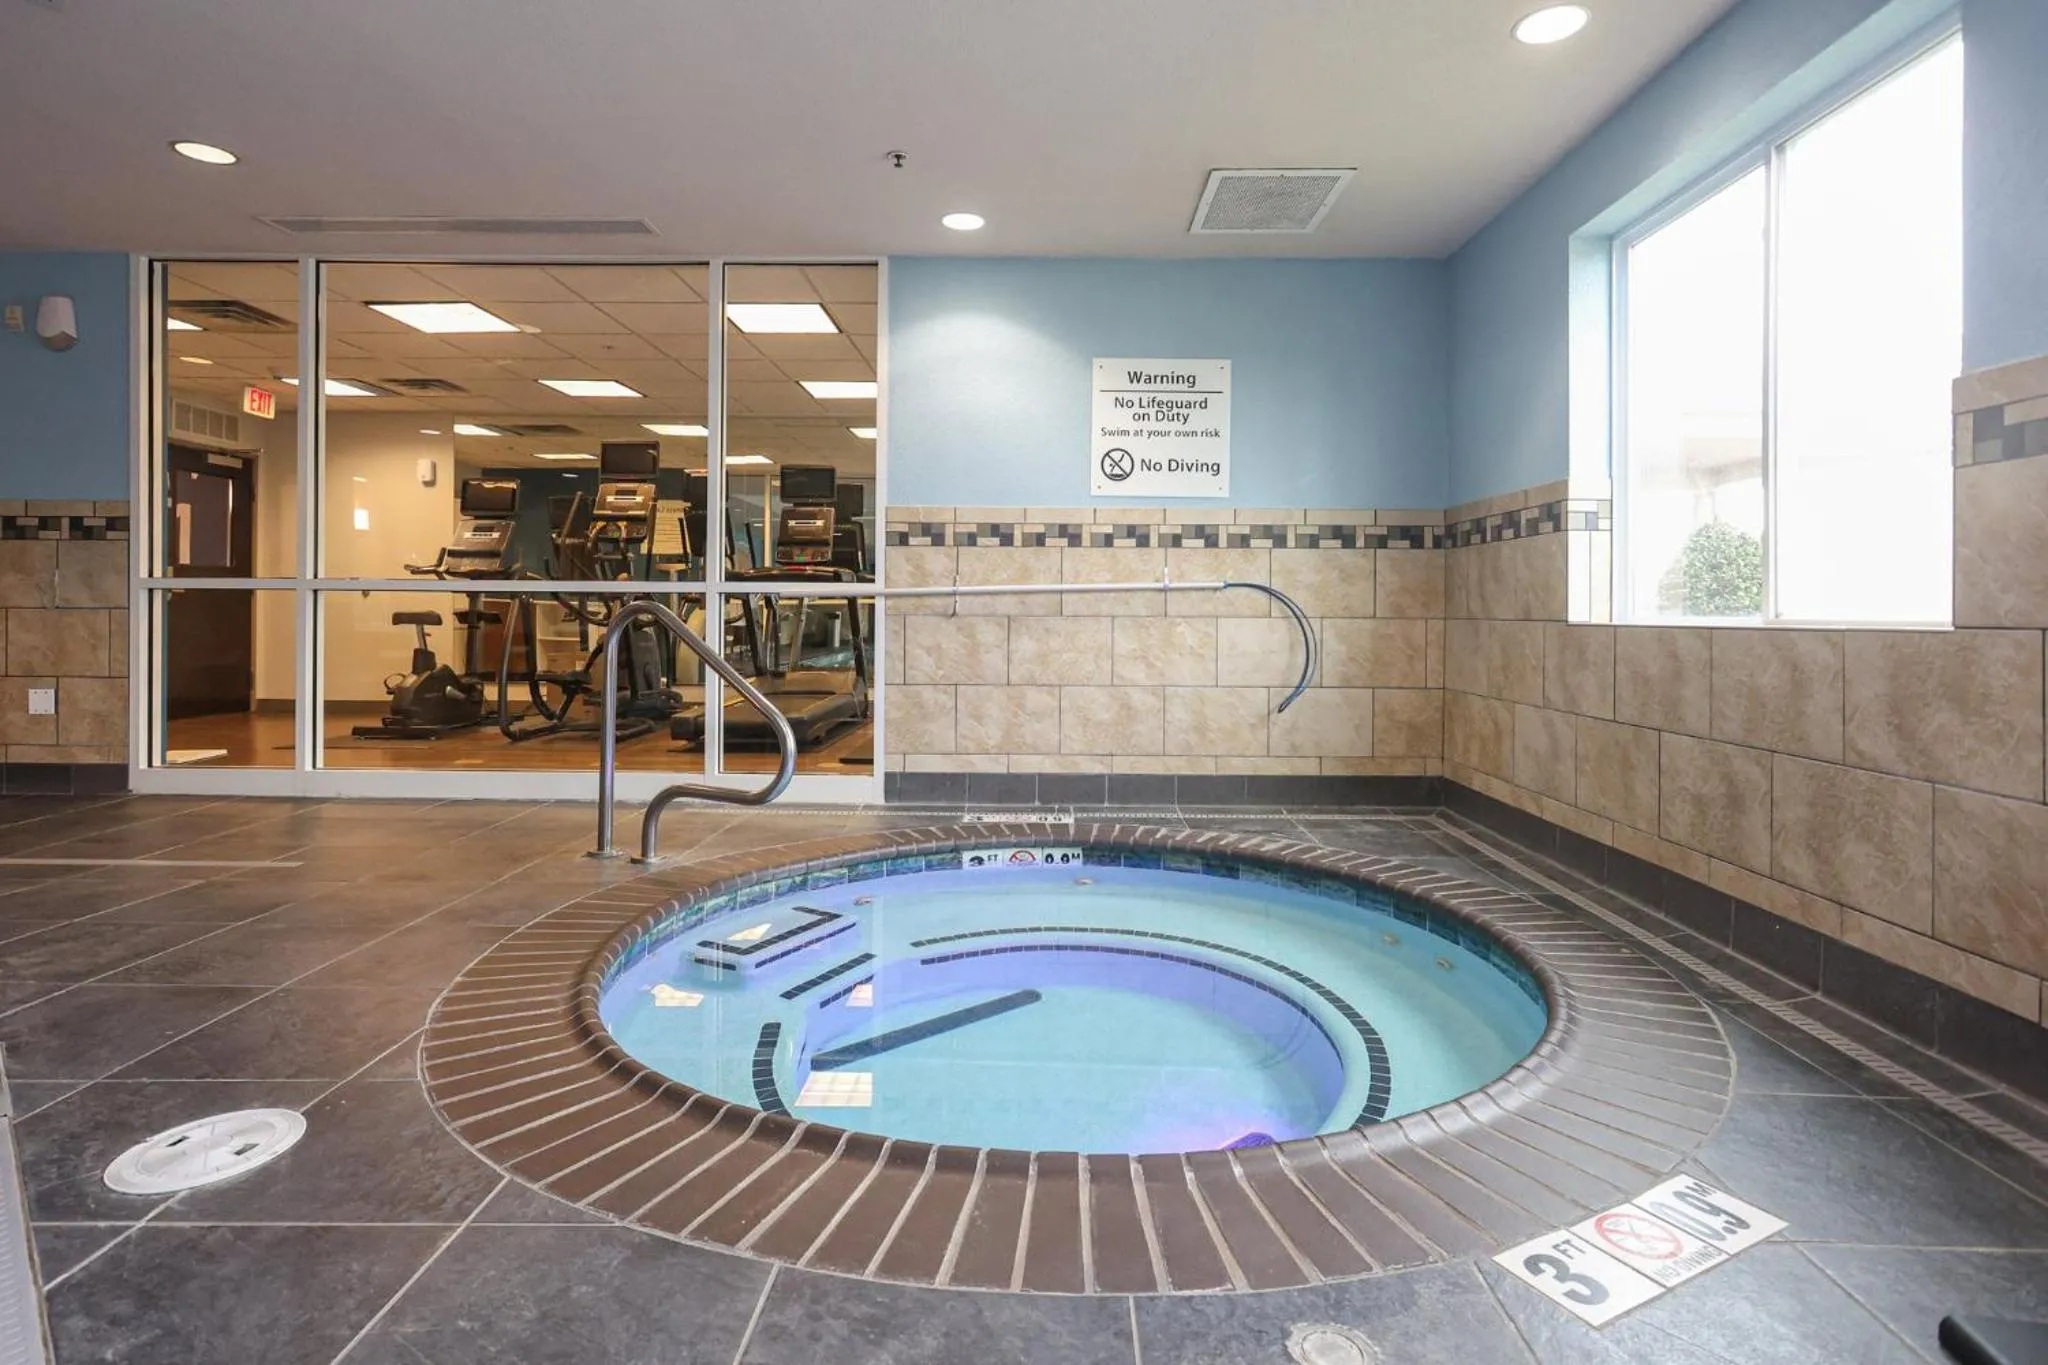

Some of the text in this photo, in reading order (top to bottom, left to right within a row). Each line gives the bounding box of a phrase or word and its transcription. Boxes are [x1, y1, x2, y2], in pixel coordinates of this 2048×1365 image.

[1127, 371, 1196, 388] Warning
[250, 389, 272, 416] EXIT
[1114, 396, 1208, 411] No Lifeguard
[1132, 411, 1190, 425] on Duty
[1101, 427, 1221, 439] Swim at your own risk
[1140, 459, 1221, 476] No Diving
[1650, 1191, 1750, 1241] 0.9
[1523, 1239, 1610, 1306] 3 FT
[1653, 1245, 1722, 1283] NO DIVING
